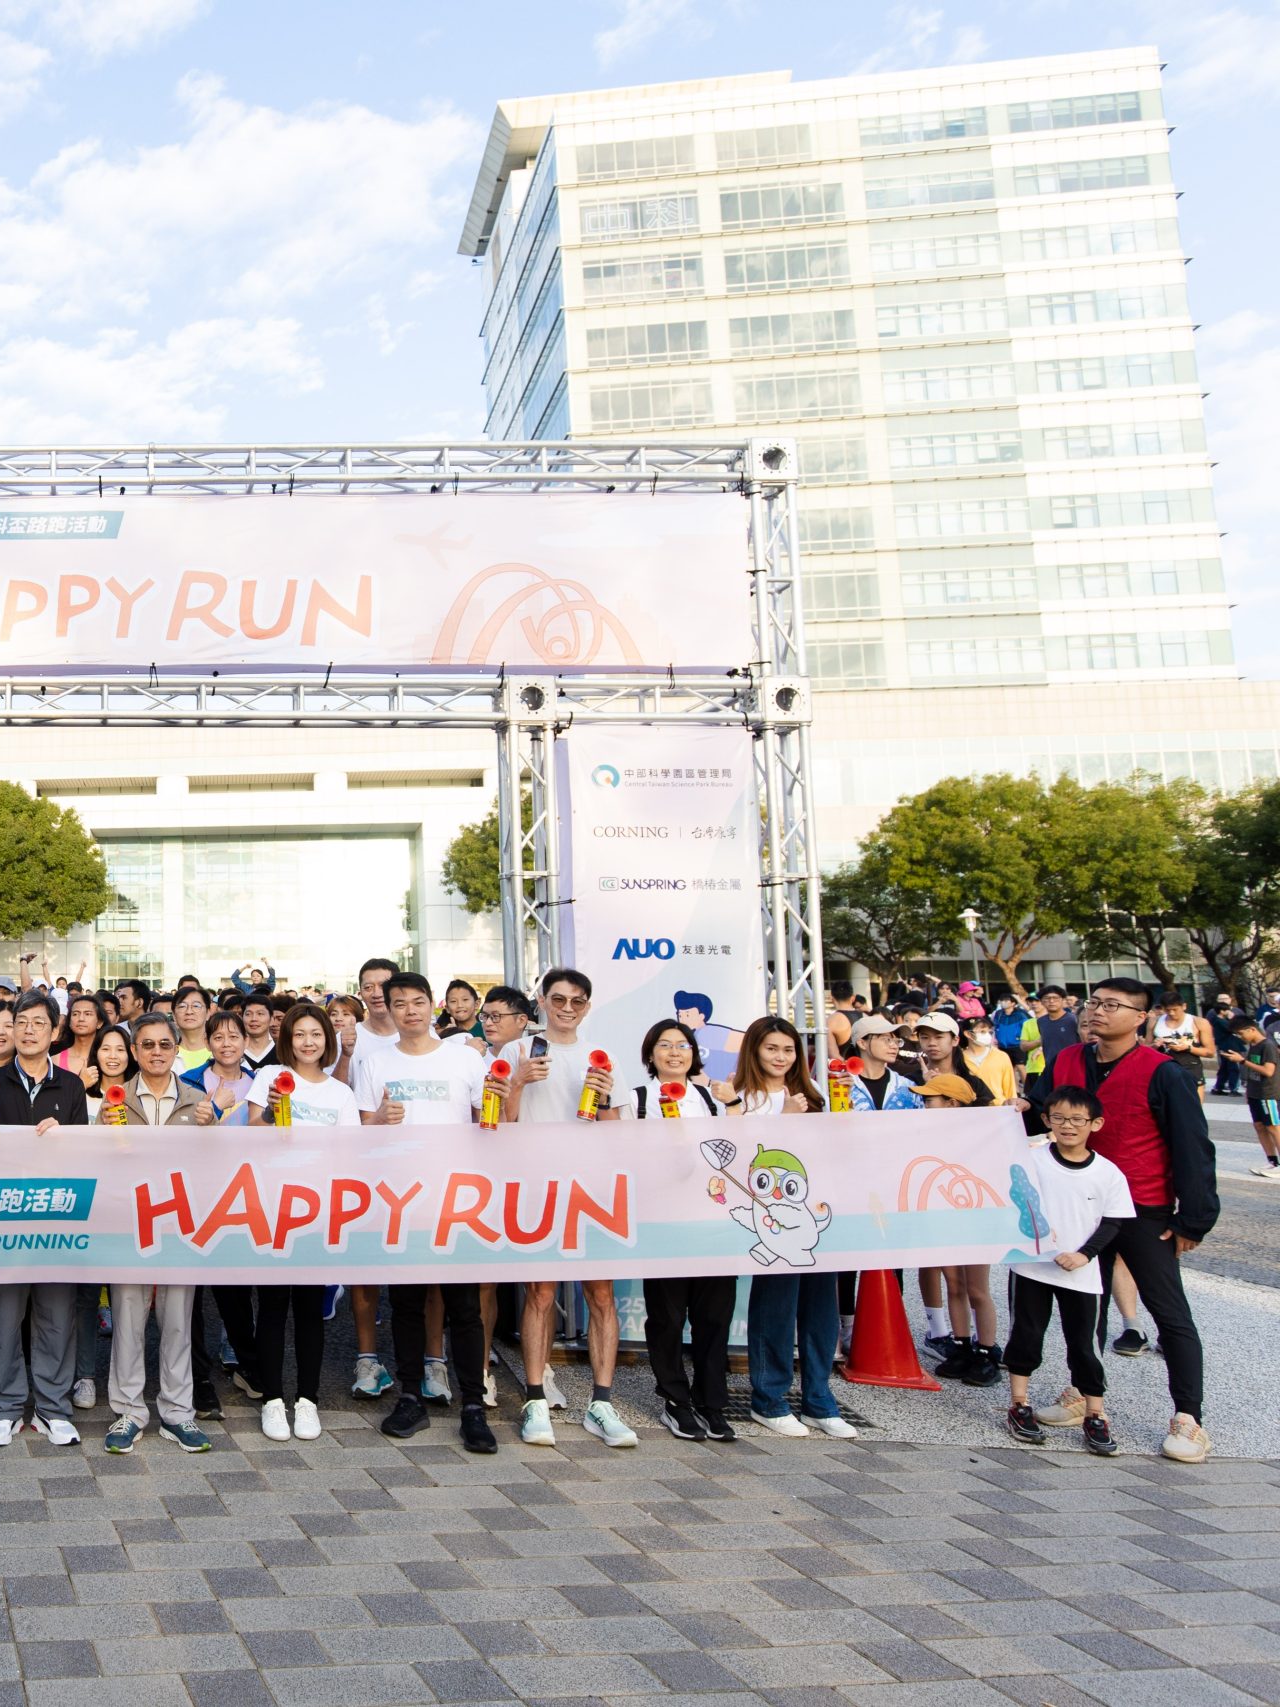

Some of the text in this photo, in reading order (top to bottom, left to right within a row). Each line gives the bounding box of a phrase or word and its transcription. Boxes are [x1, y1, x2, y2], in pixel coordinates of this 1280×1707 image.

[166, 570, 372, 646] RUN
[624, 768, 732, 779] 中部科學園區管理局
[593, 826, 669, 838] CORNING
[620, 879, 687, 891] SUNSPRING
[612, 938, 732, 960] AUO 友達光電
[134, 1162, 424, 1250] HAPPY
[434, 1172, 628, 1251] RUN
